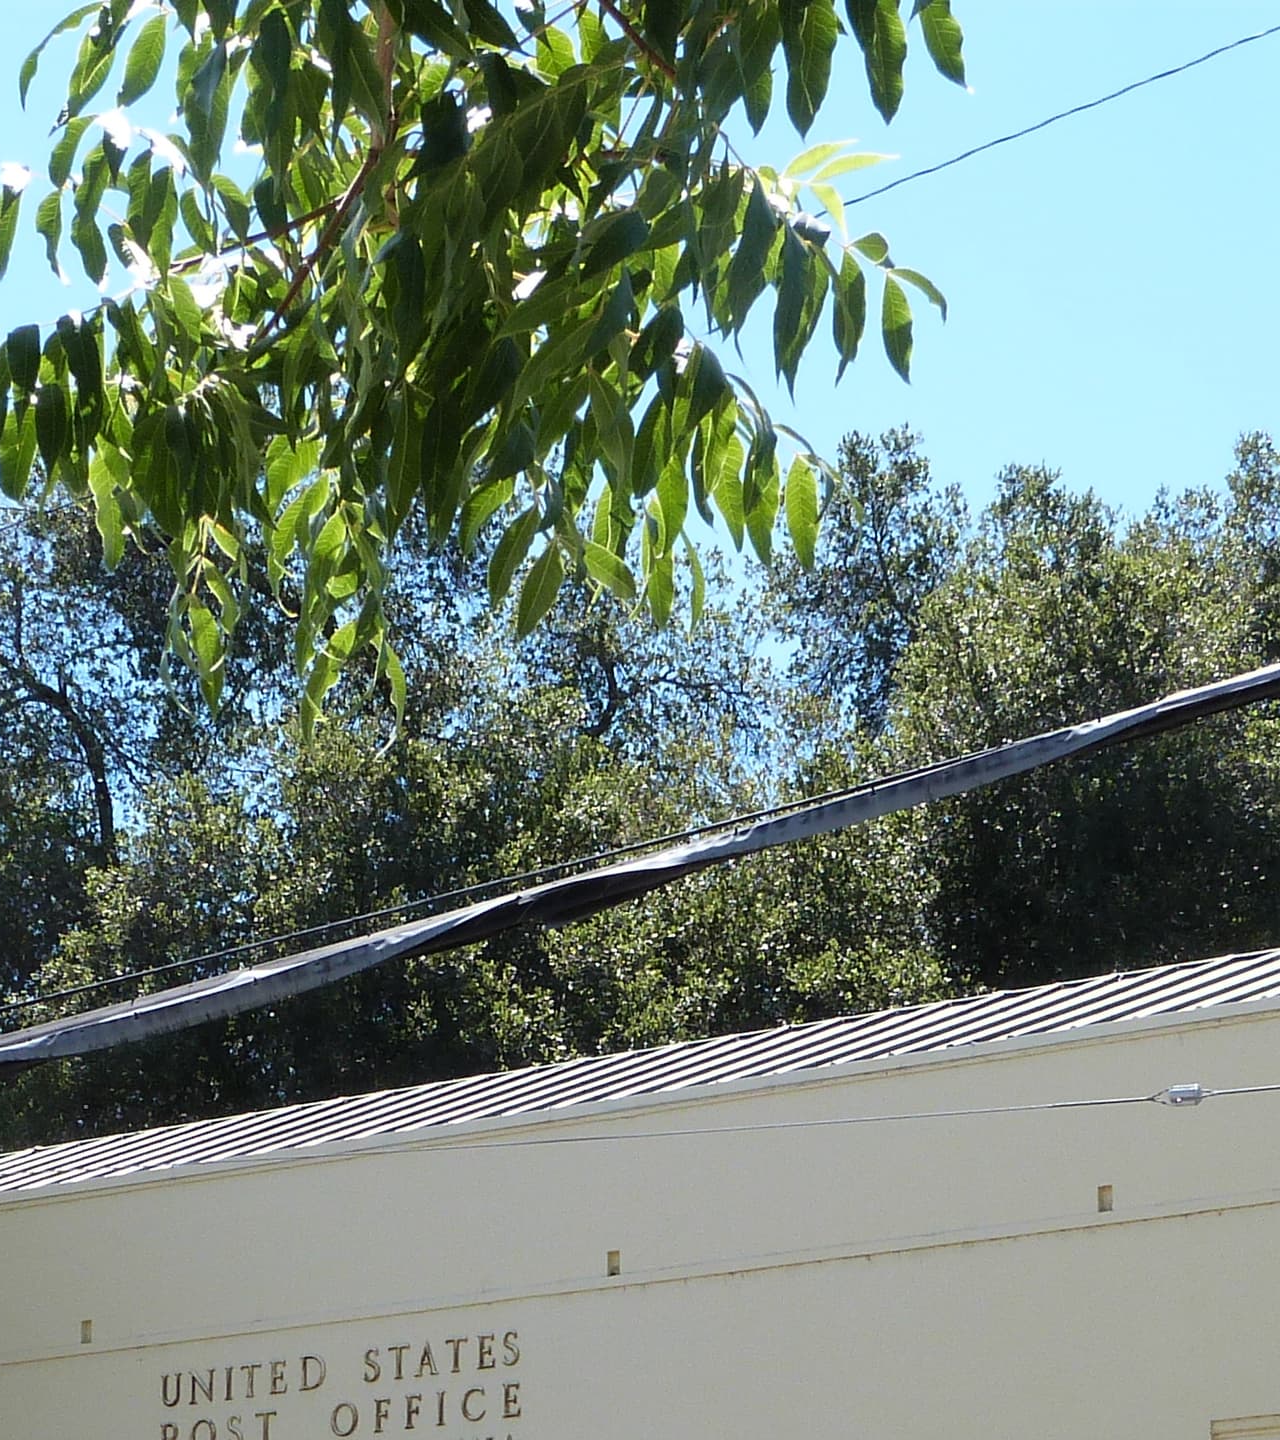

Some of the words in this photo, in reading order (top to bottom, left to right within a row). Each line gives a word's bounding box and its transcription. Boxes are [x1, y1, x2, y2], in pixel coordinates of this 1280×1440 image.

[160, 1354, 327, 1407] UNITED
[363, 1331, 520, 1384] STATES
[330, 1383, 521, 1437] OFFICE
